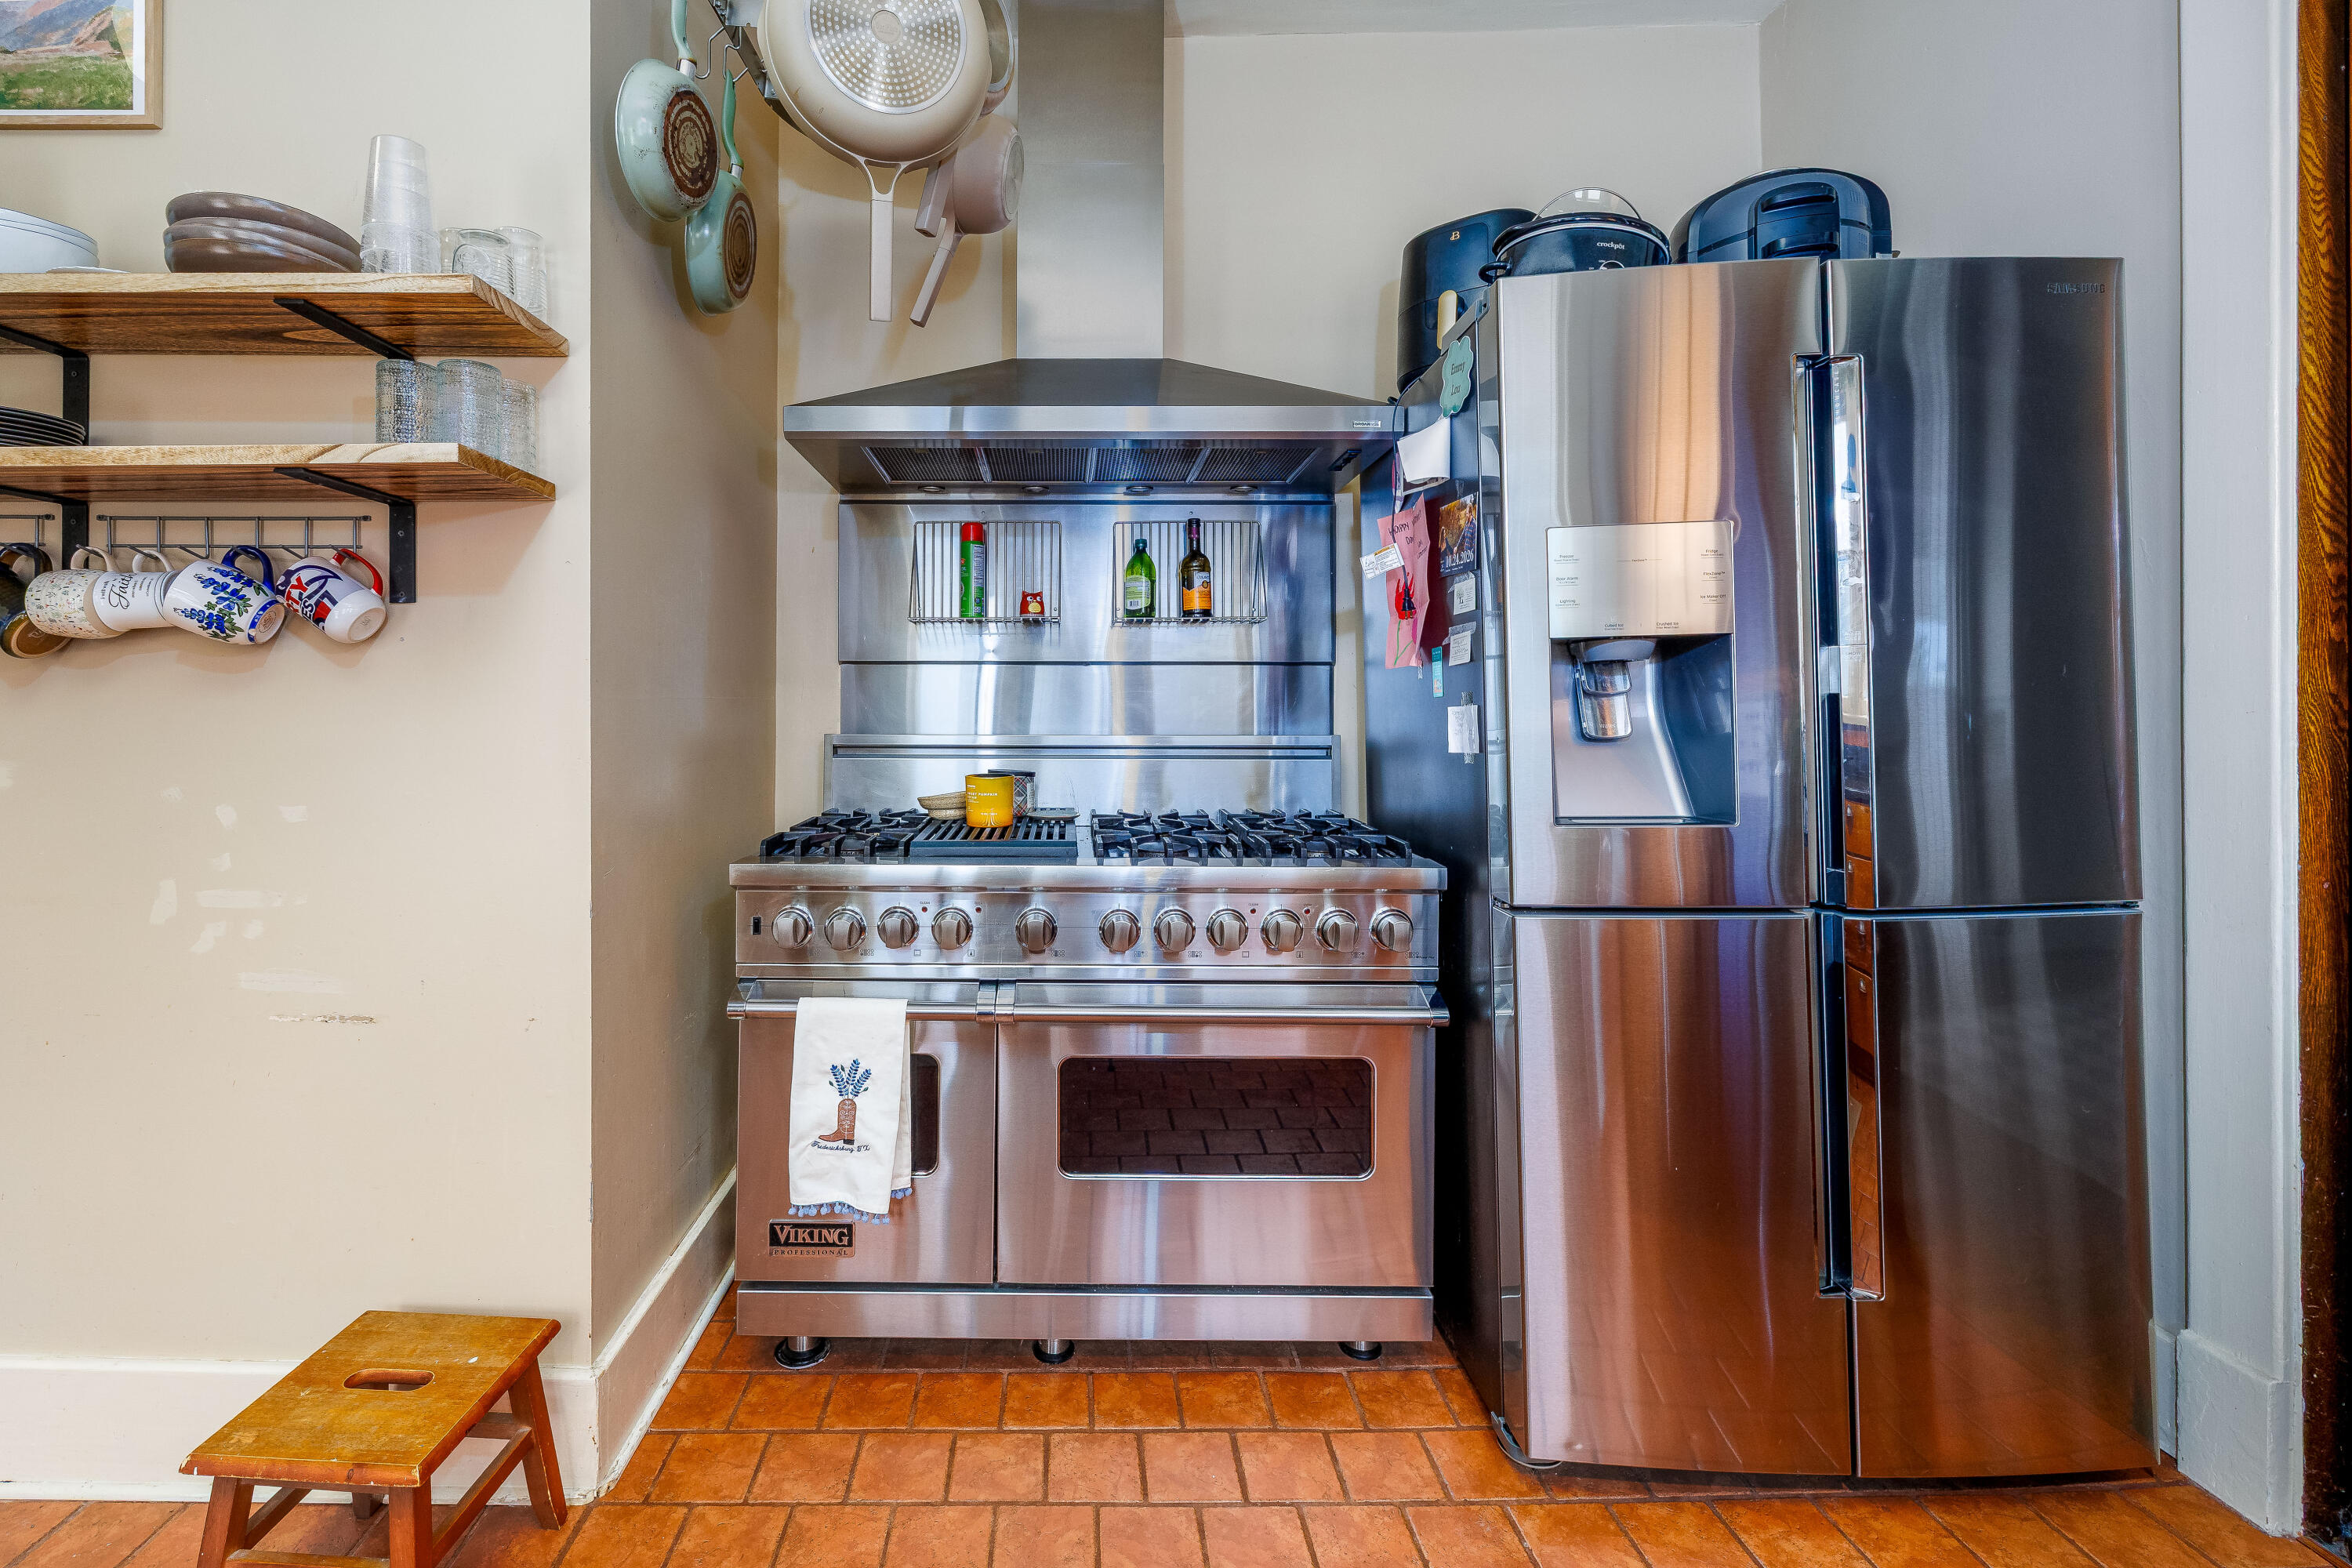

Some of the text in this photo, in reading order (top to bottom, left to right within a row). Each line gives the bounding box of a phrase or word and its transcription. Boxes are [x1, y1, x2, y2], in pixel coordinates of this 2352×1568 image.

[2047, 283, 2106, 294] SAMSUNG
[108, 572, 138, 610] Faith
[773, 1225, 849, 1246] VIKING
